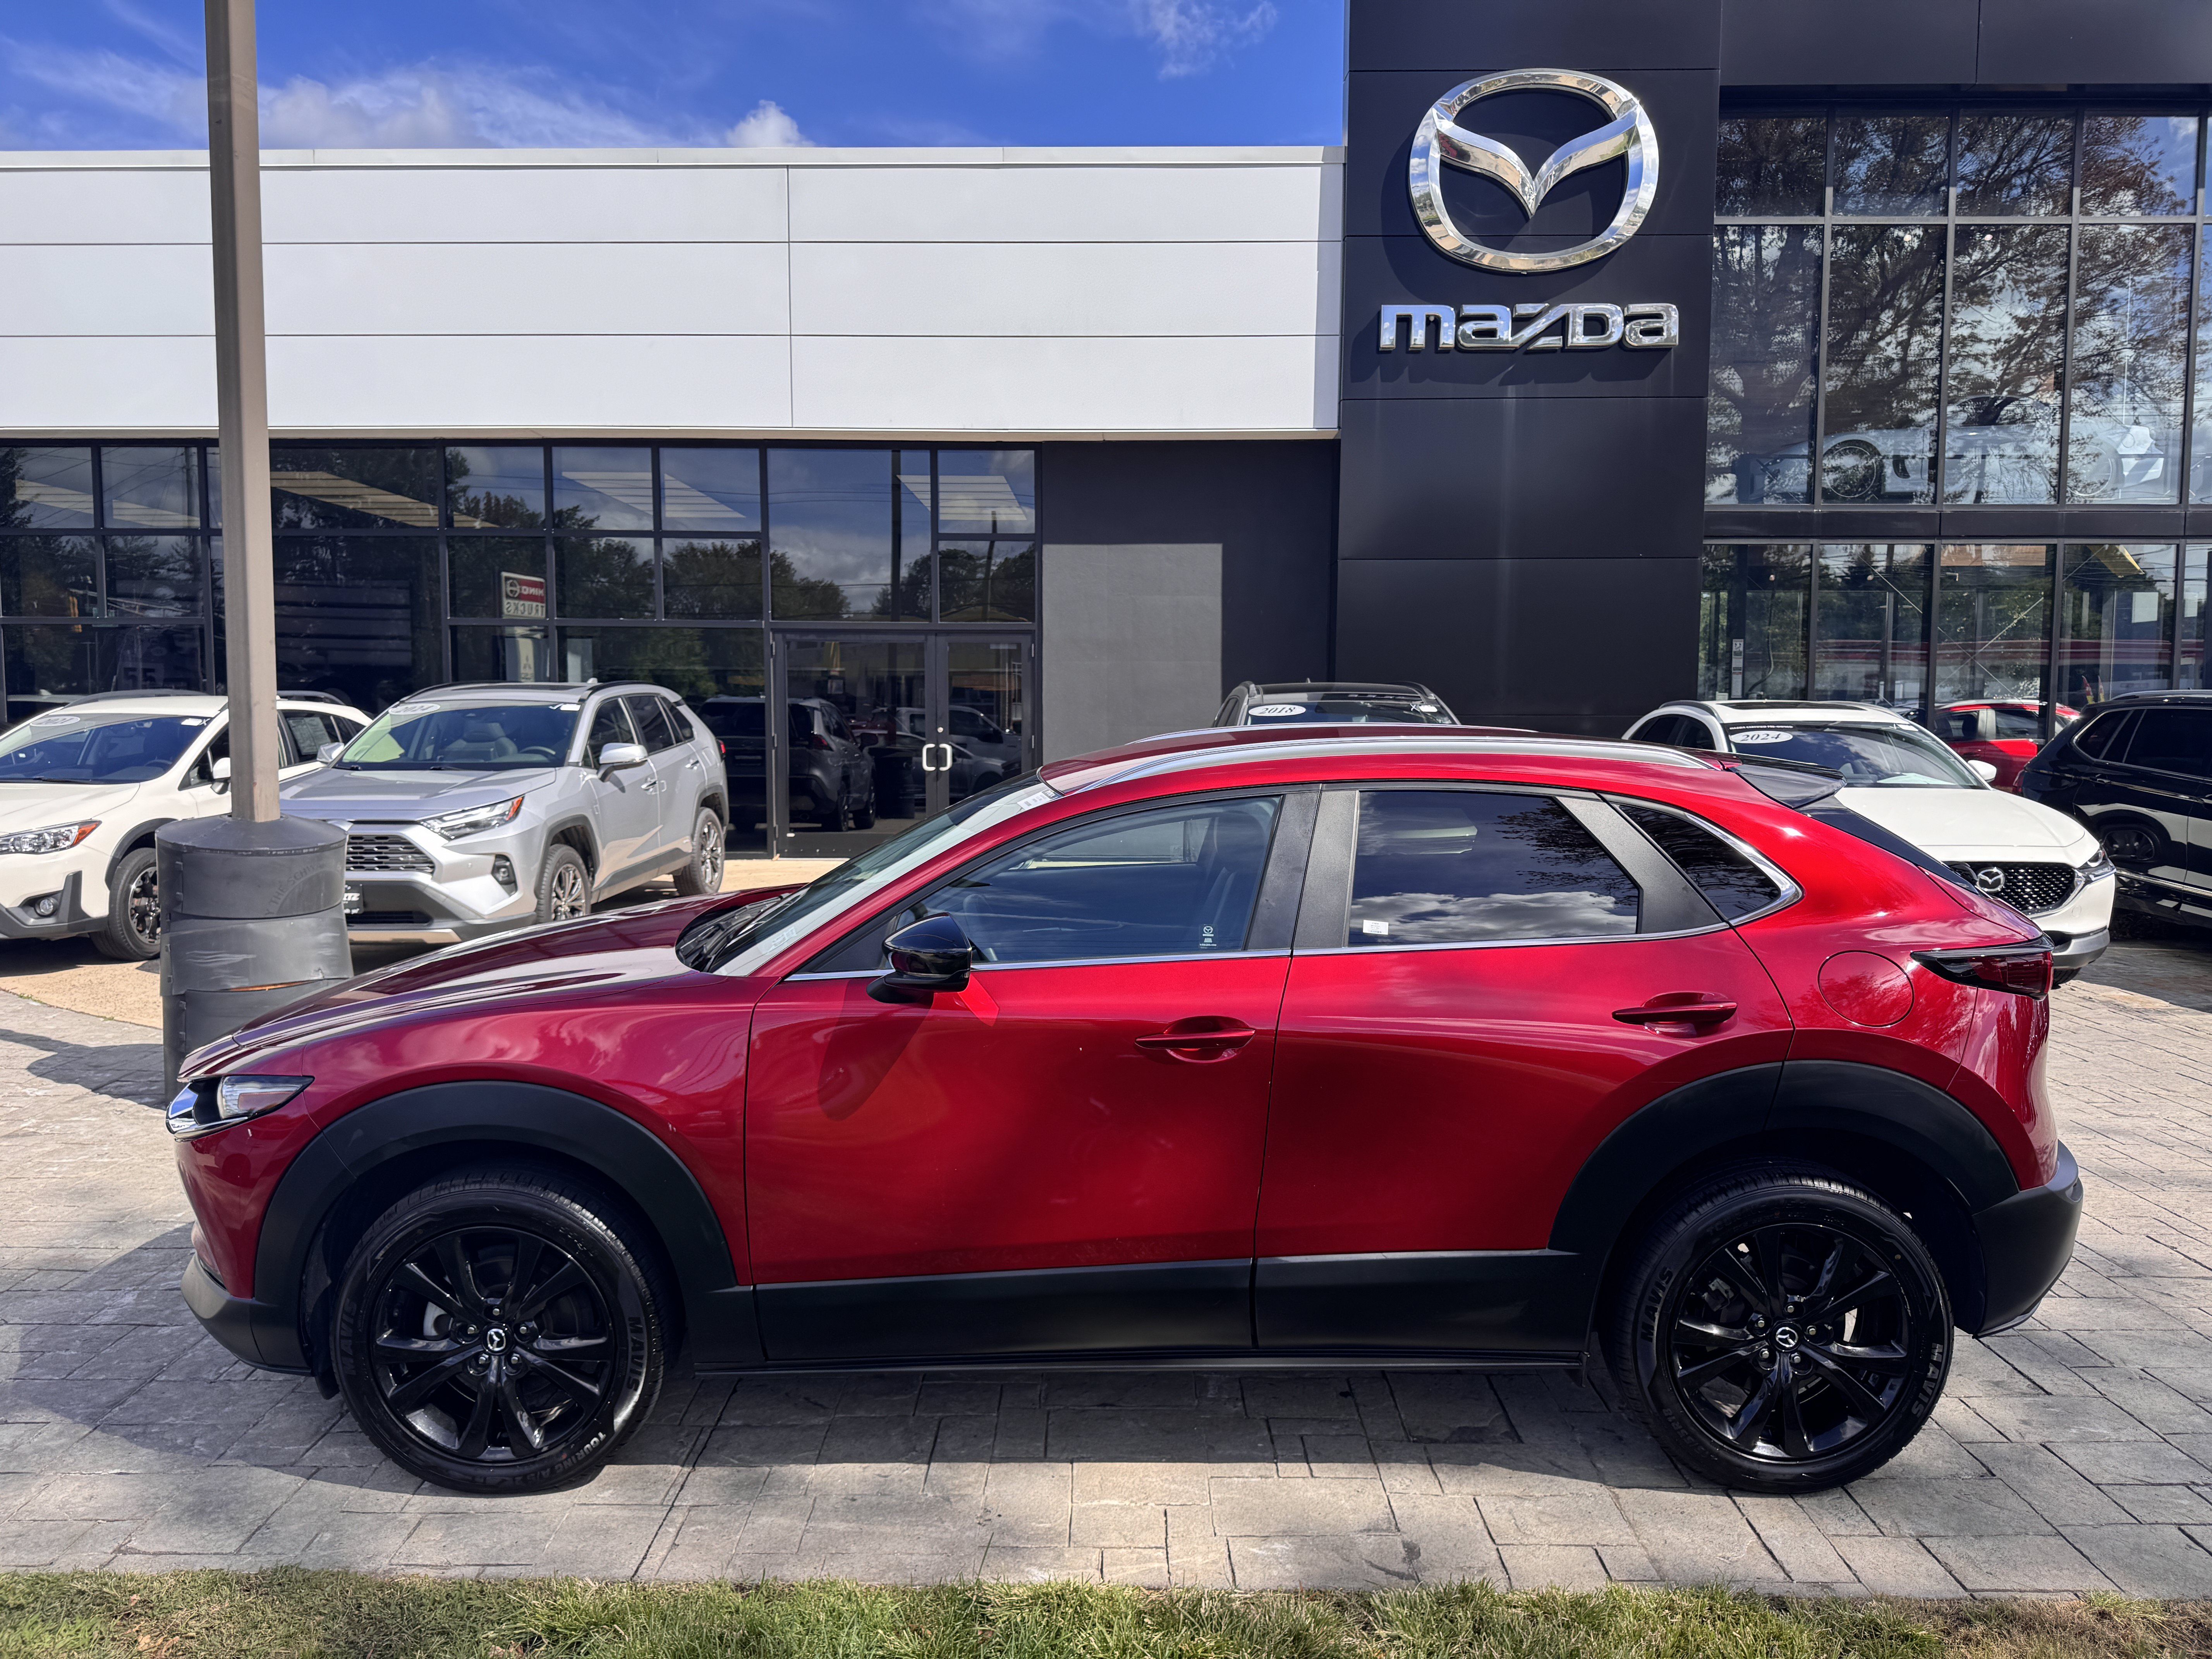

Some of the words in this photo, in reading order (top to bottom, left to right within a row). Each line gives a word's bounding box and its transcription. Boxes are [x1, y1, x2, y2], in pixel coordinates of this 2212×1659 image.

[1740, 733, 1781, 742] 2024
[340, 1298, 357, 1375] MAVIS
[1640, 1267, 1673, 1343] MAVIS
[627, 1317, 644, 1392] MAVIS
[1911, 1343, 1944, 1417] MAVIS
[555, 1431, 606, 1473] TOURING
